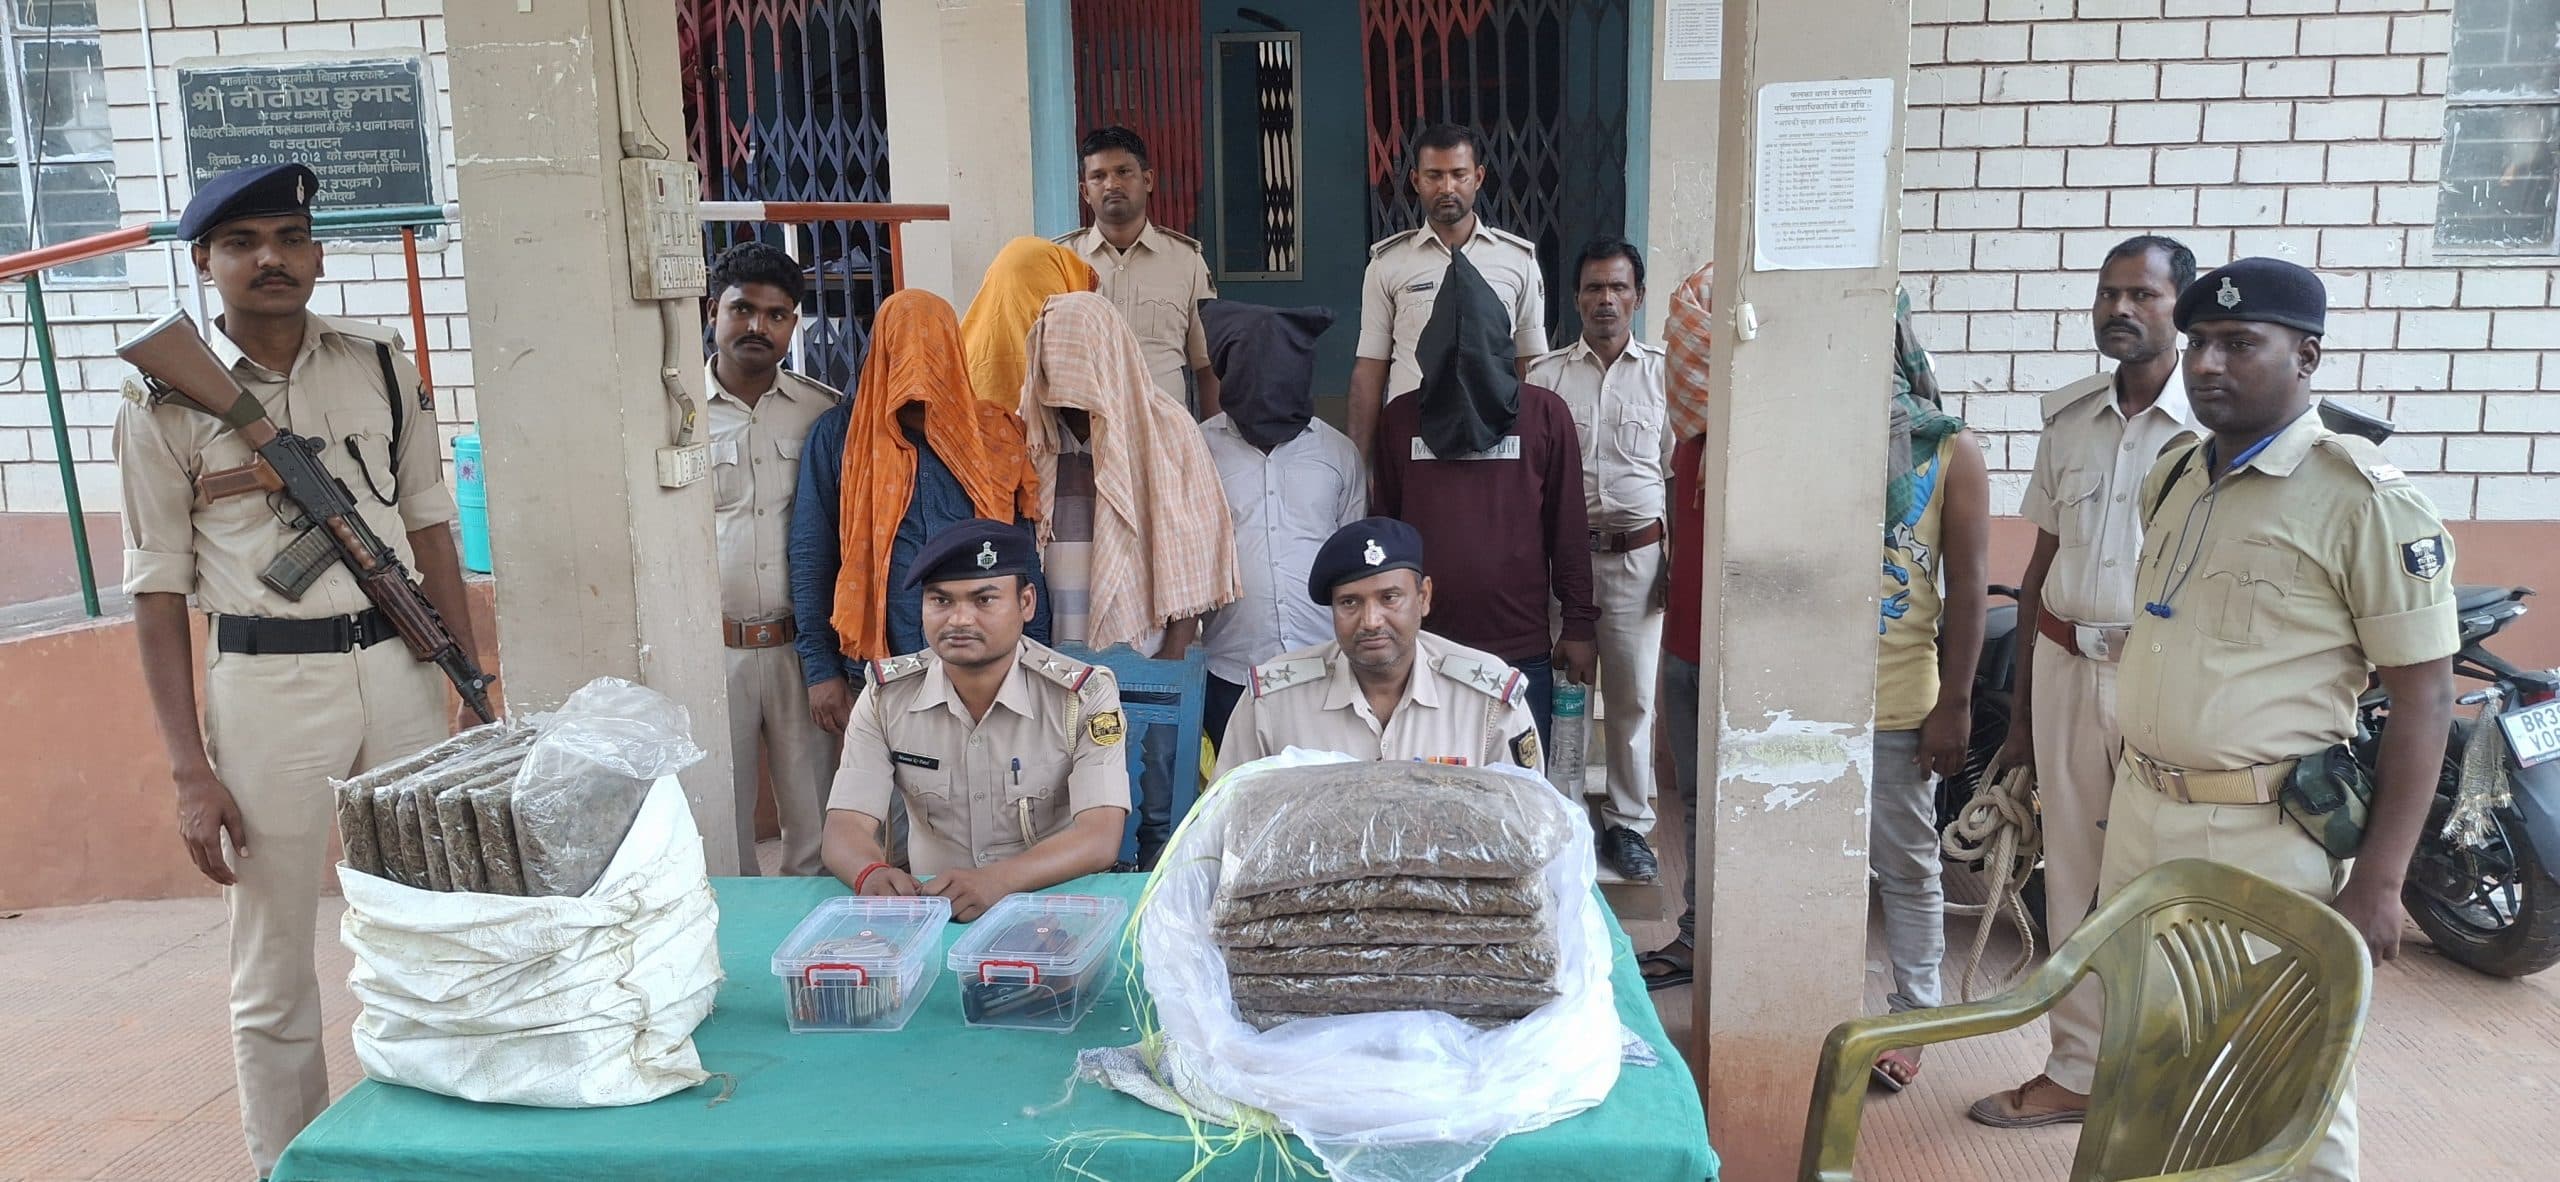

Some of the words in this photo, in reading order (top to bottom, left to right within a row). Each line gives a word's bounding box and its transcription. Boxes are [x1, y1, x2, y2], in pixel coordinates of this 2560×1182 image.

[192, 85, 224, 111] श्री
[230, 84, 329, 110] नीतीश
[334, 84, 411, 109] कुमार
[362, 119, 386, 131] थाना
[269, 140, 285, 149] का
